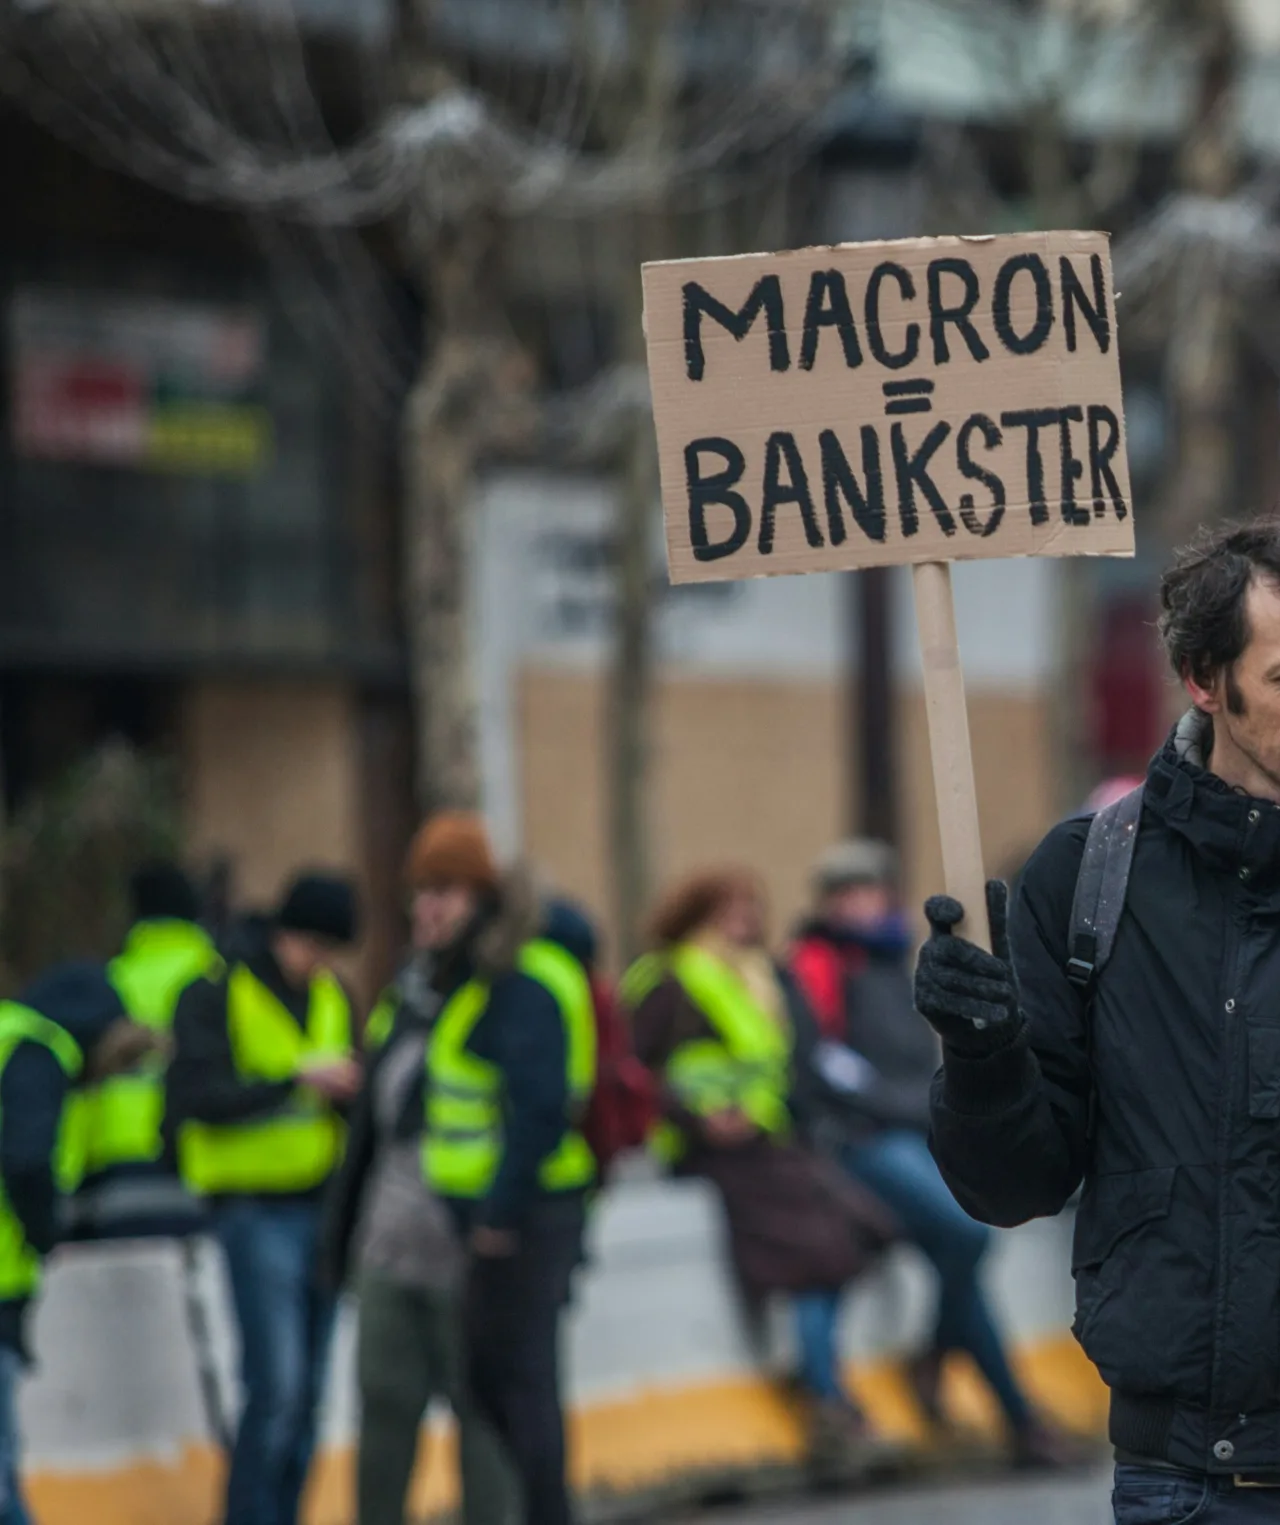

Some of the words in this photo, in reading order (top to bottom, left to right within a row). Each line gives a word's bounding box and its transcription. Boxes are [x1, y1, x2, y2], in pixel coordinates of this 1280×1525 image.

[681, 252, 1110, 382] MACRON
[881, 377, 936, 415] =
[683, 404, 1128, 562] BANKSTER
